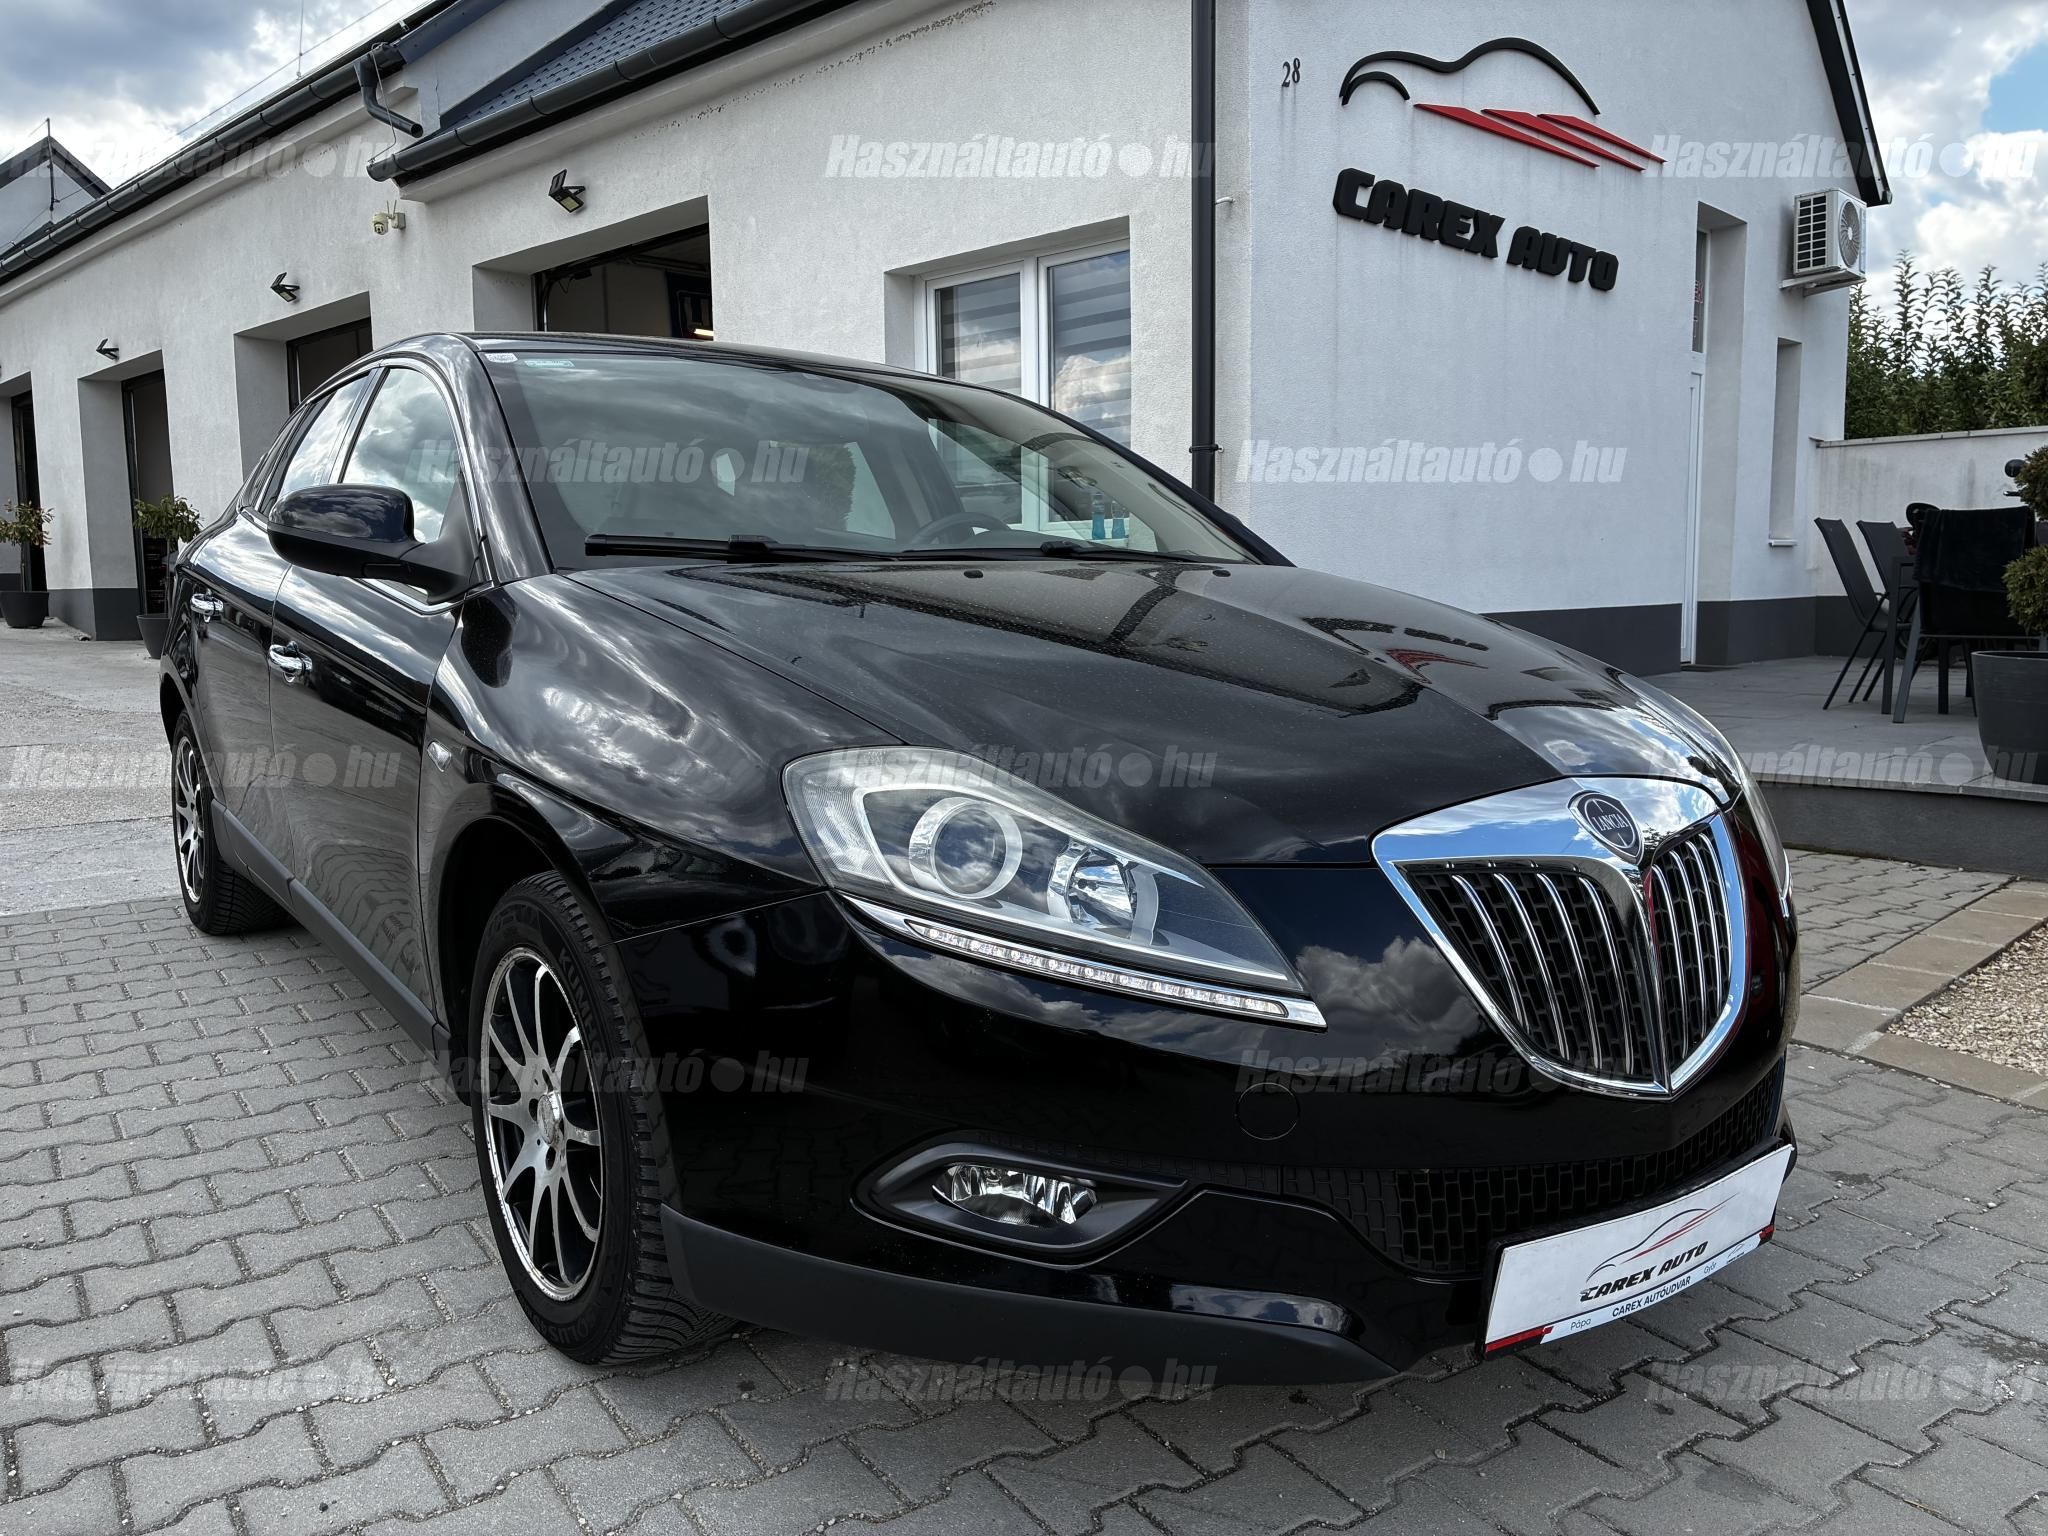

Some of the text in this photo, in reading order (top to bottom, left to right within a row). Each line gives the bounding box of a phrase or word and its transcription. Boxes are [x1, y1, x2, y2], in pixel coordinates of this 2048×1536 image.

[1281, 57, 1300, 87] 28
[1332, 167, 1619, 291] CAREX AUTO
[1592, 813, 1629, 831] LANCIA
[1580, 1241, 1708, 1302] CAREX AUTO
[1612, 1275, 1691, 1318] CAREX AUTÓUDVAR
[1570, 1318, 1592, 1331] Pápa
